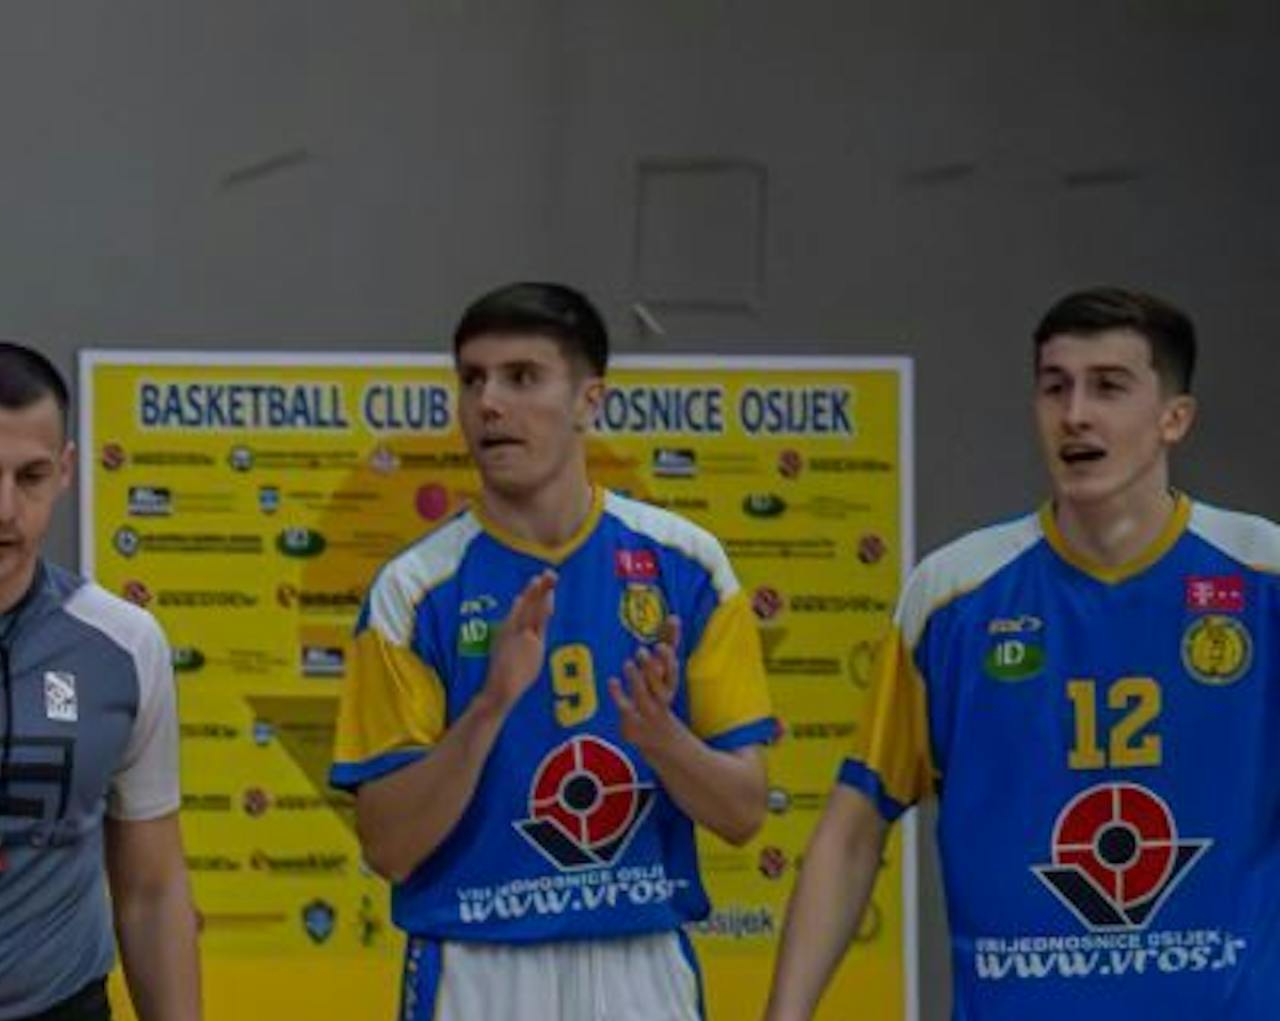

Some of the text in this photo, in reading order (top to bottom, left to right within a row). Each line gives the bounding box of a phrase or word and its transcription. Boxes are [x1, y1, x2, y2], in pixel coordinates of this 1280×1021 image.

[141, 384, 853, 433] BASKETBALL CLUB OSNICE OSIJEK
[550, 643, 599, 728] 9
[1065, 676, 1163, 770] 12
